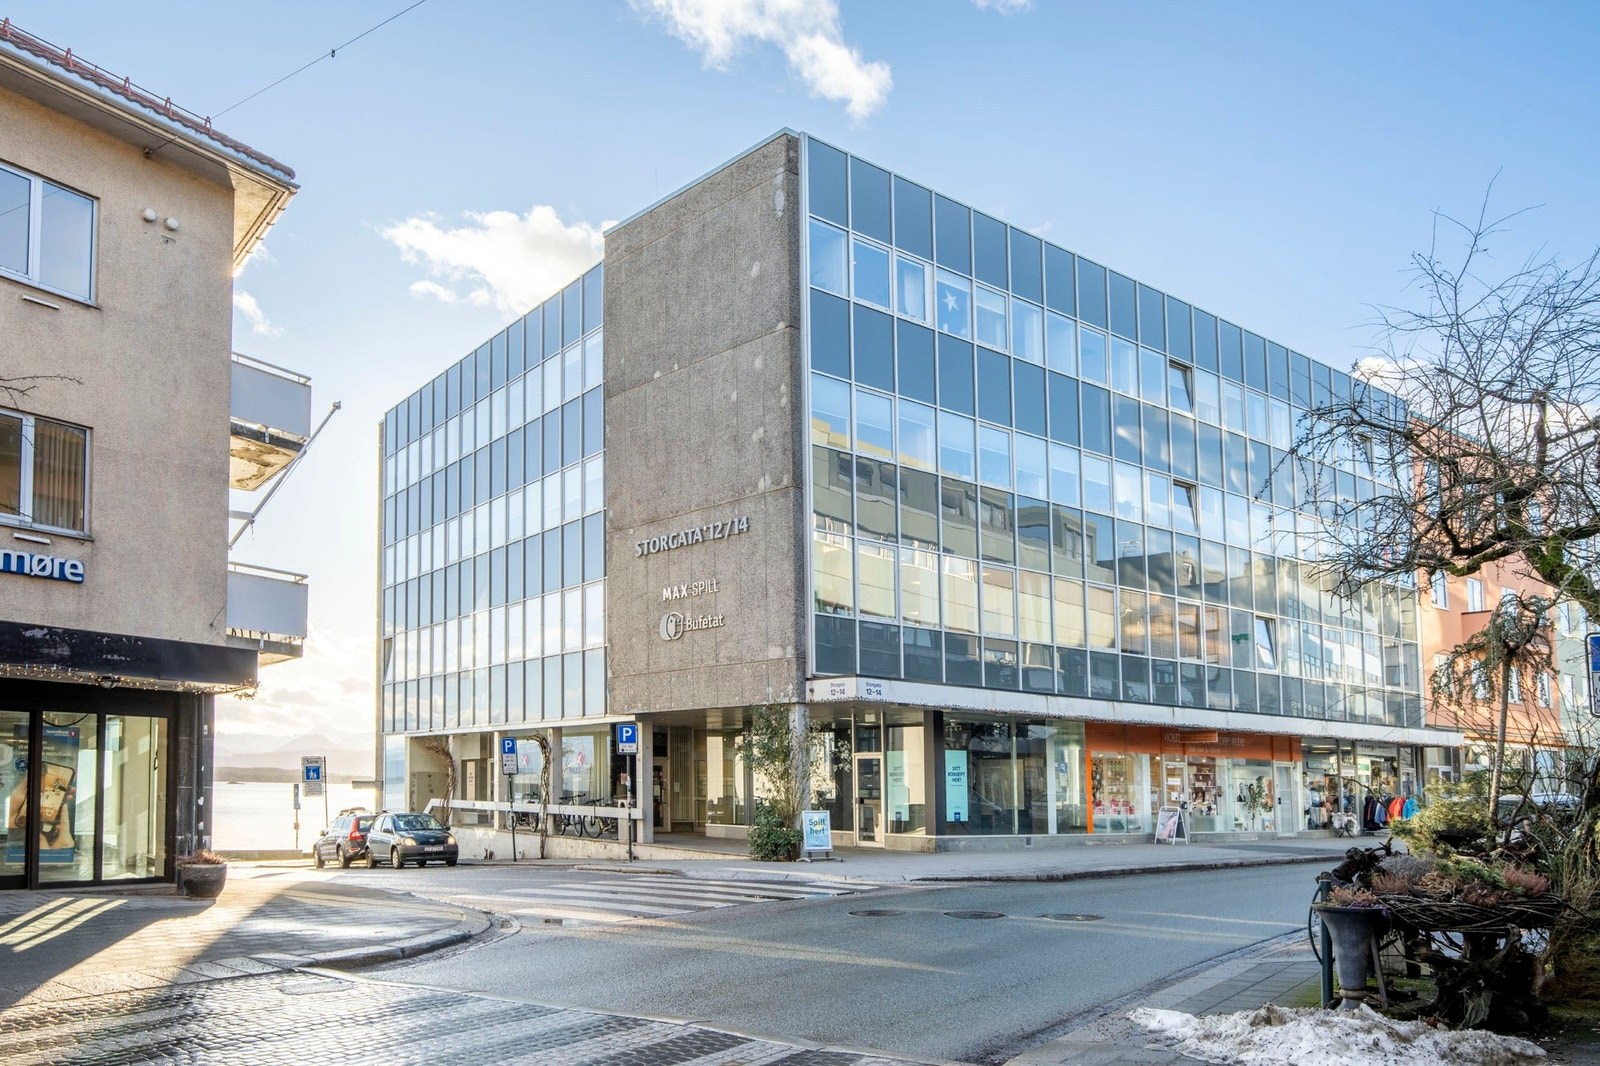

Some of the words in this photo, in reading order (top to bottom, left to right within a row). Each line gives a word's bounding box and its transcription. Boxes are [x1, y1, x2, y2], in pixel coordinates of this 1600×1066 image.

[635, 527, 703, 557] STORGATA
[708, 515, 749, 541] 12/14
[662, 583, 689, 601] MAX
[691, 579, 720, 597] SPILL
[685, 612, 725, 631] Bufetat
[830, 688, 846, 696] 12-14
[866, 688, 882, 696] 12-14
[622, 727, 633, 742] P
[504, 740, 513, 753] P
[808, 818, 826, 828] Spill
